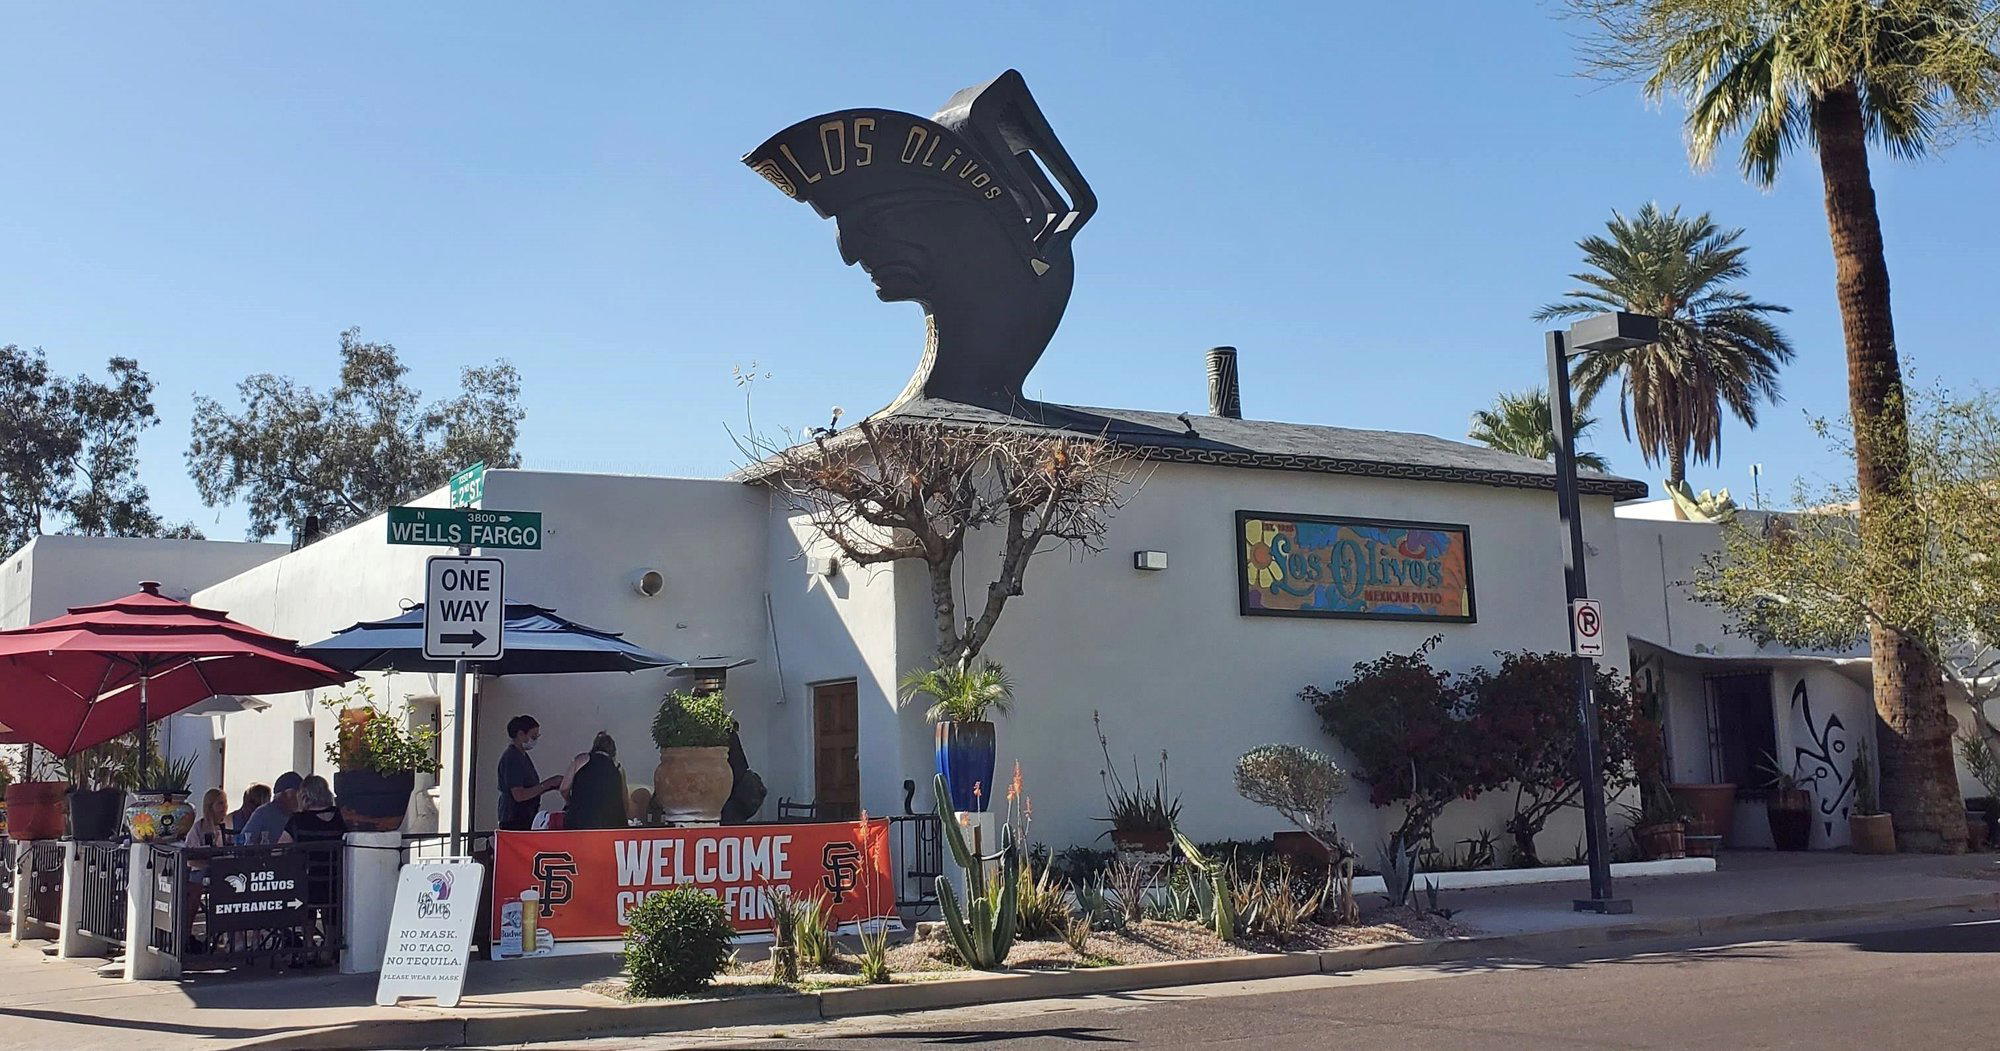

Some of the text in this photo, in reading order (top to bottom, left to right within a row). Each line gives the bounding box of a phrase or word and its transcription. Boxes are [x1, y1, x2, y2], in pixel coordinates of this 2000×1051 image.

[780, 117, 876, 185] LOS
[417, 511, 496, 523] N 3800
[391, 521, 538, 546] WELLS FARGO
[1269, 532, 1443, 600] Los Olivos
[441, 568, 490, 591] ONE
[1364, 589, 1442, 605] MEXICAN PATIO
[440, 600, 490, 622] WAY
[614, 834, 793, 887] WELCOME
[250, 871, 275, 881] LOS
[250, 880, 295, 892] OLIVOS
[215, 900, 283, 914] ENTRANCE
[400, 930, 458, 939] NO MASK.
[399, 944, 453, 952] NO TACO.
[386, 957, 462, 966] NO TEQUILA.
